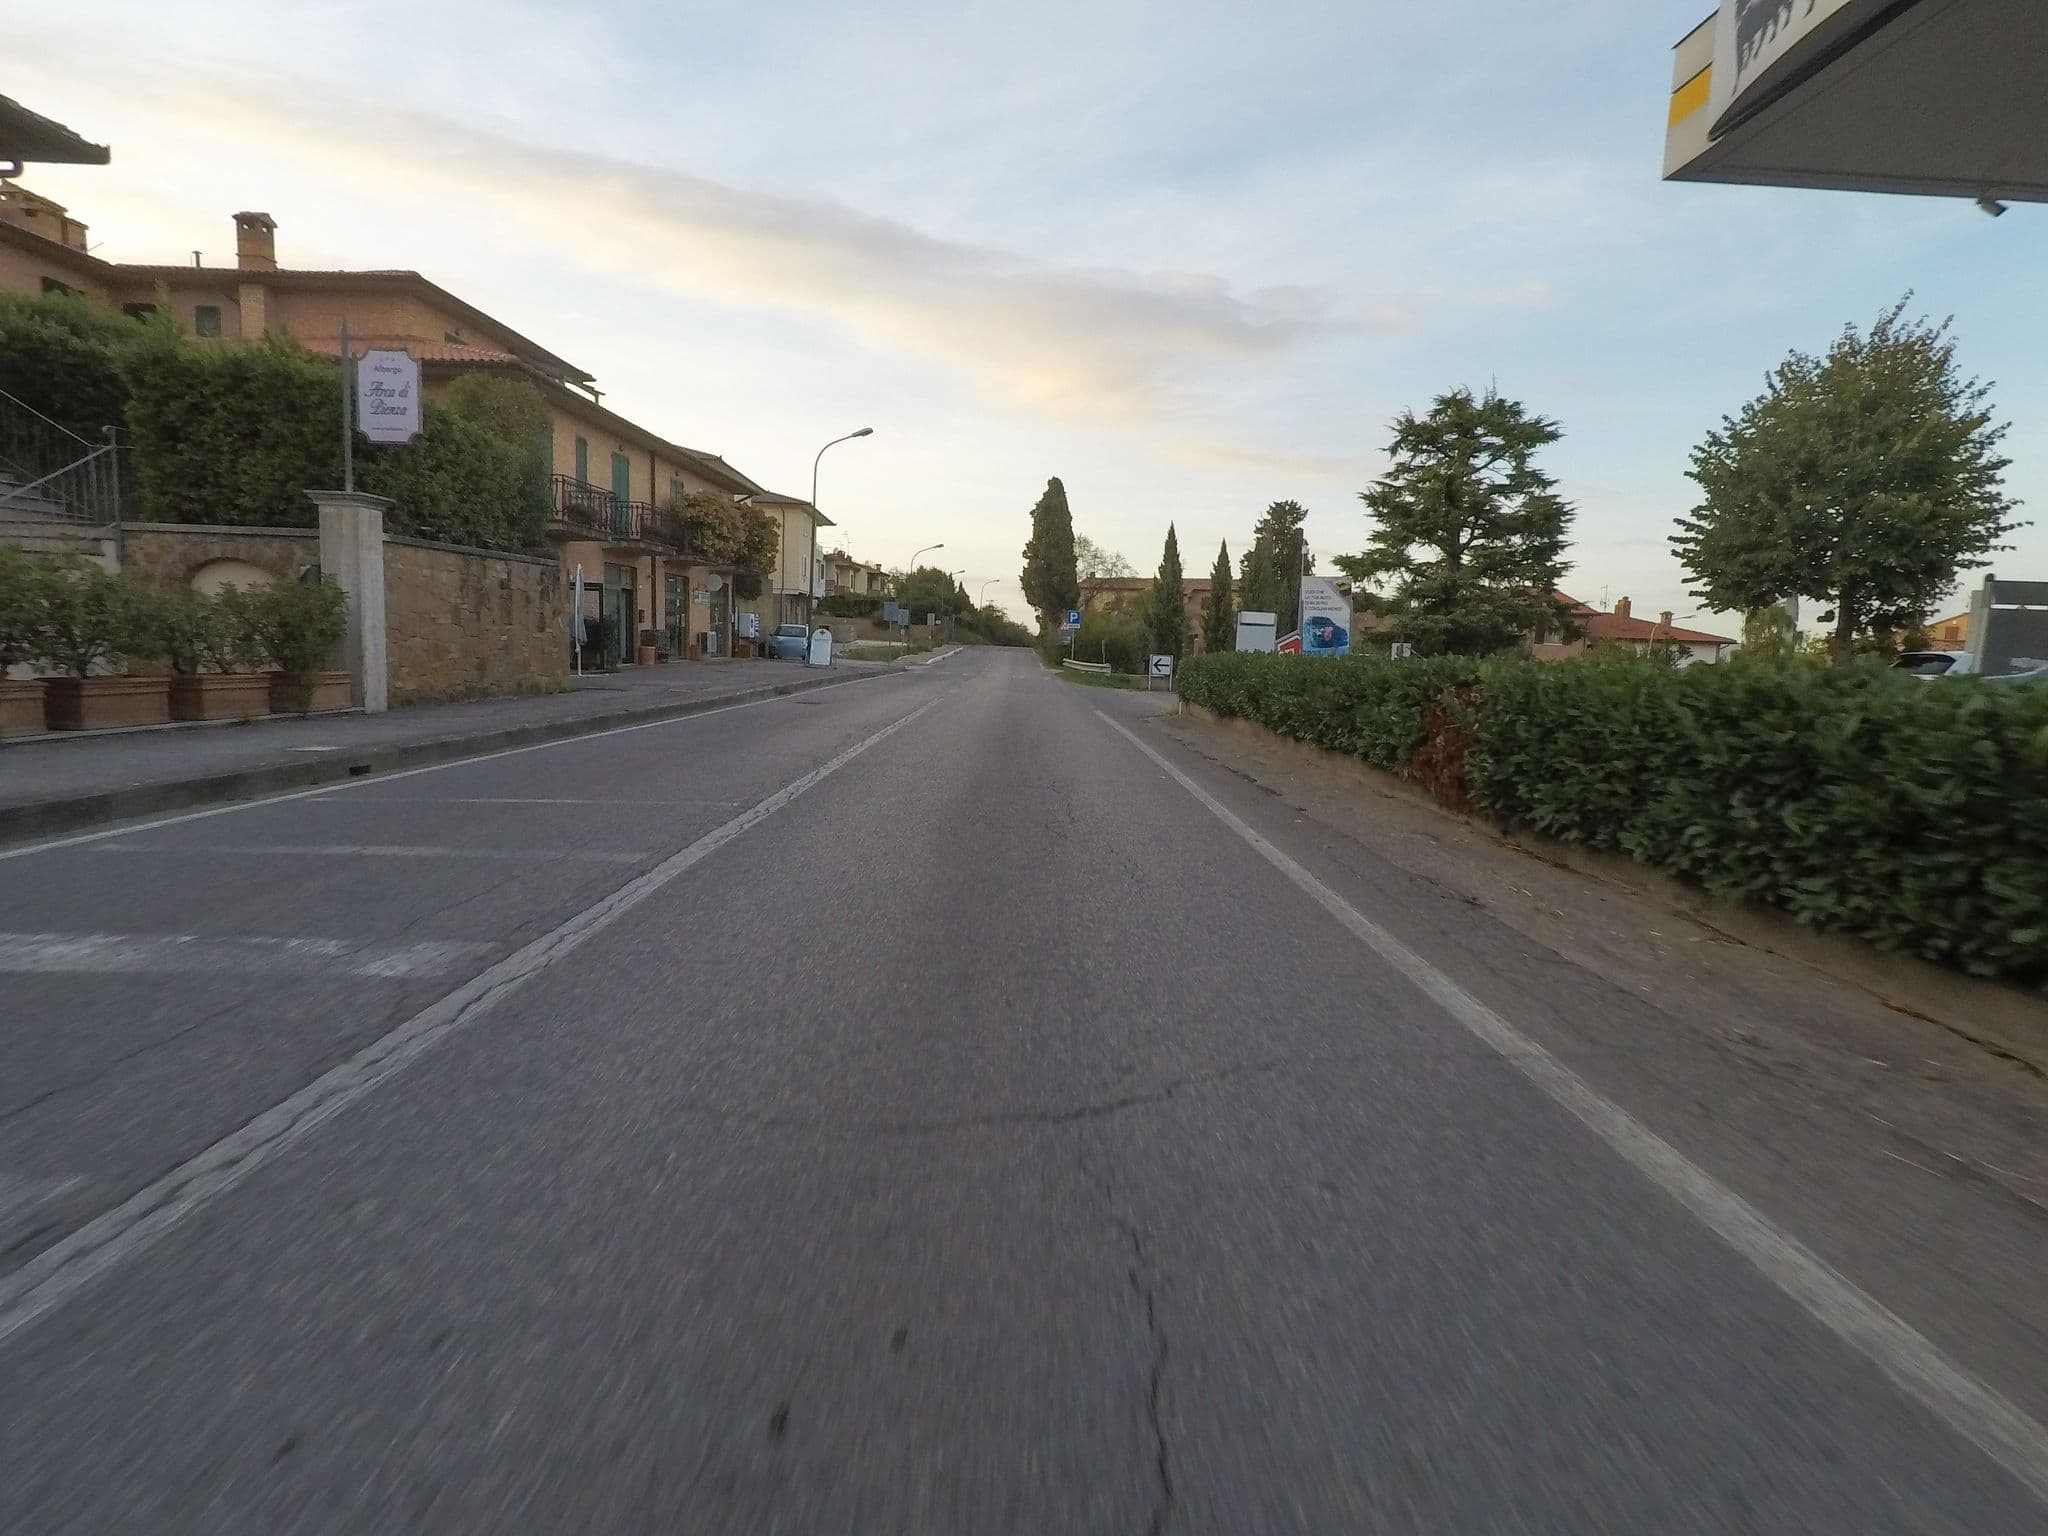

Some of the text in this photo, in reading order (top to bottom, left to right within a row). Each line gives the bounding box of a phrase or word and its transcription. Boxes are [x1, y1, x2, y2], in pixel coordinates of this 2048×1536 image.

[374, 365, 402, 374] Albergo
[398, 381, 411, 397] di
[1070, 612, 1078, 622] P
